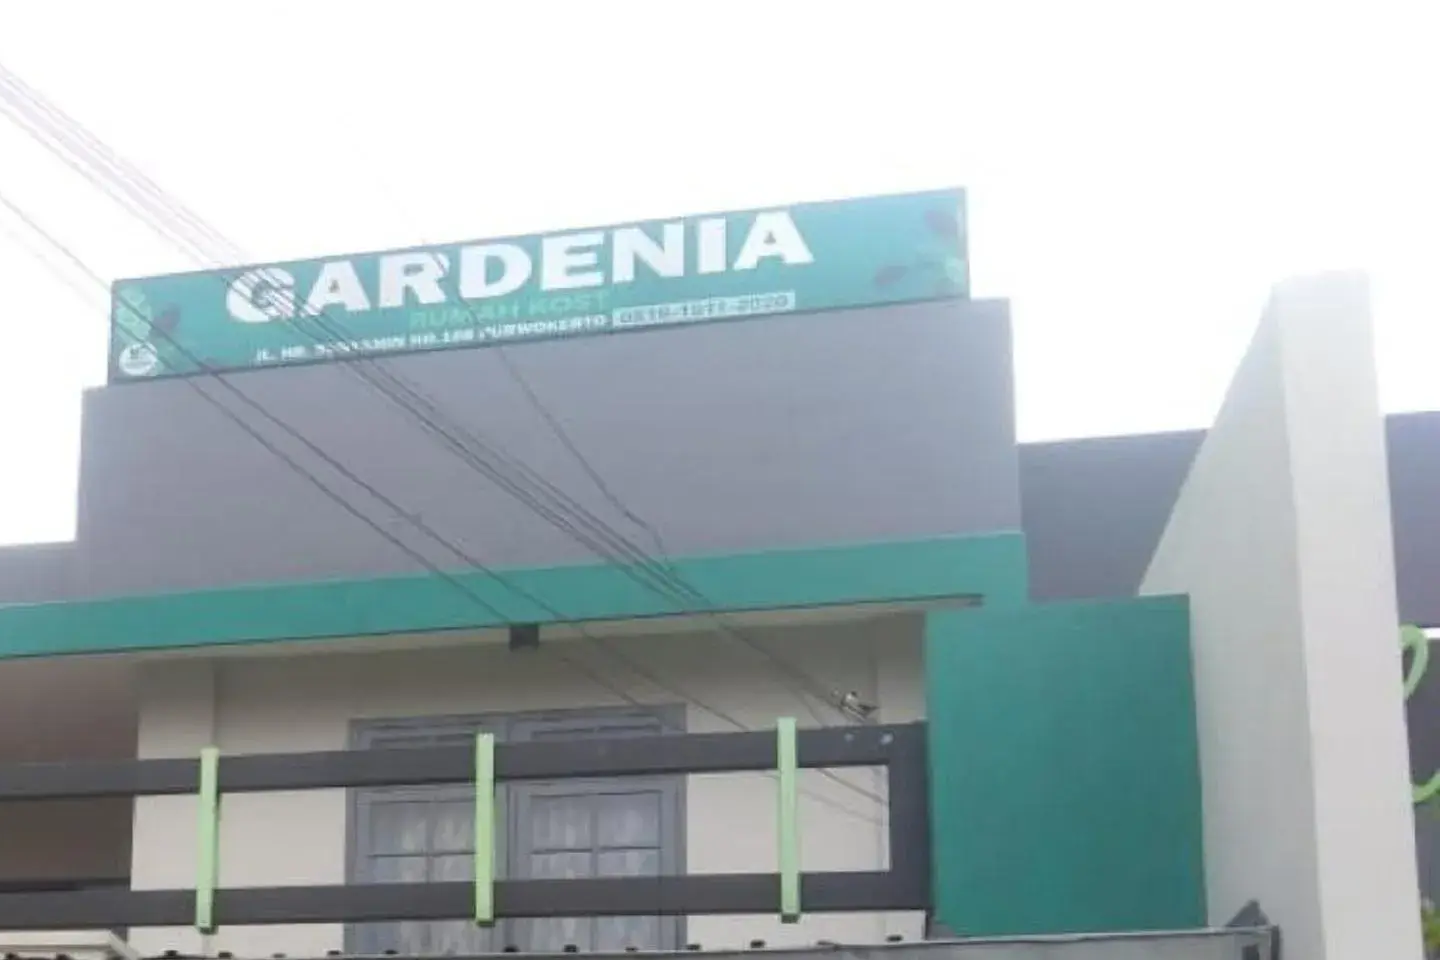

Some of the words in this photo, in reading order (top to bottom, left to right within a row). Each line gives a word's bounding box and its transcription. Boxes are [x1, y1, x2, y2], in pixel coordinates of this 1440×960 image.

[226, 211, 814, 323] GARDENIA
[412, 300, 520, 327] RUMAH
[529, 291, 610, 316] KOST
